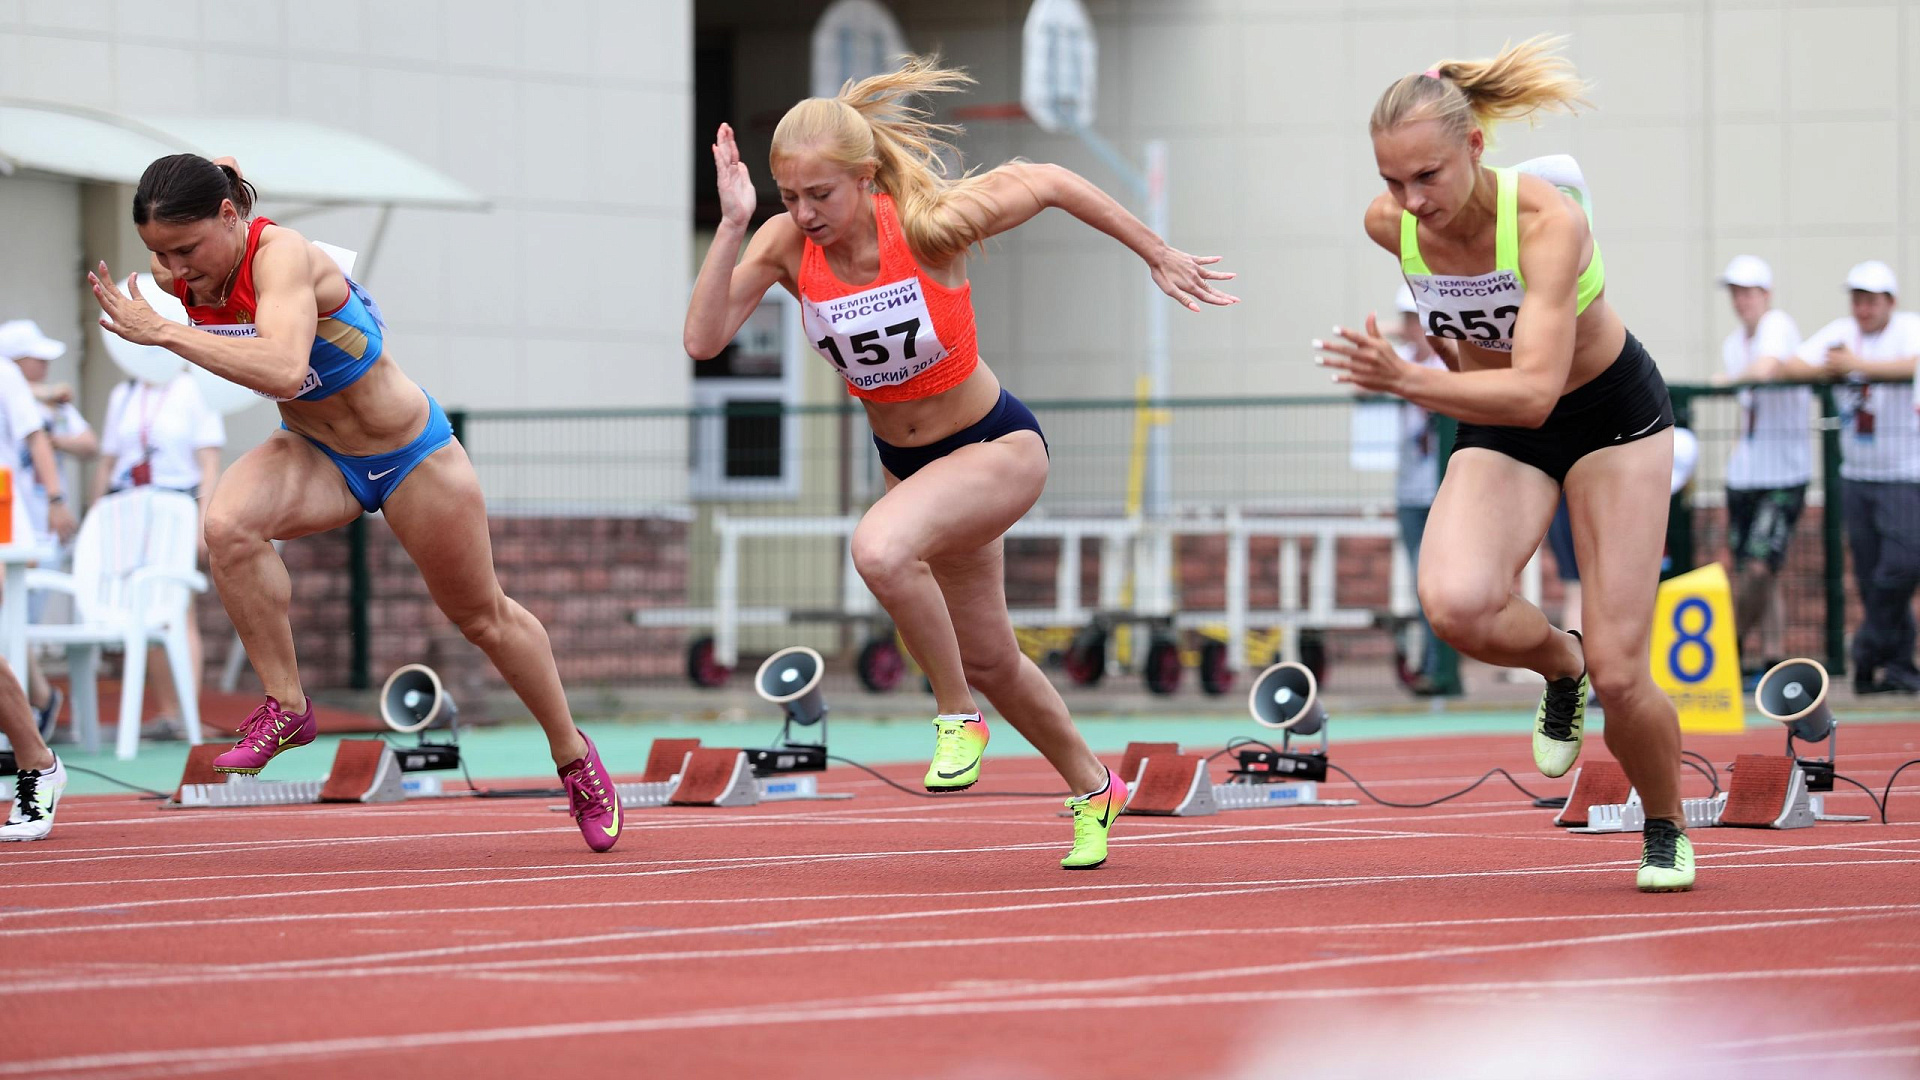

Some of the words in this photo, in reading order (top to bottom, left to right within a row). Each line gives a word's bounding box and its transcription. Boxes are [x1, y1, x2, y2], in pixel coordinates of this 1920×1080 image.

[1435, 273, 1512, 288] ЧЕМПИОНАТ
[1439, 282, 1516, 297] РОССИИ
[830, 283, 915, 312] ЧЕМПИОНАТ
[831, 292, 918, 323] РОССИИ
[1429, 305, 1520, 341] 652
[817, 317, 921, 369] 157
[912, 351, 942, 375] 2017
[1669, 597, 1714, 683] 8
